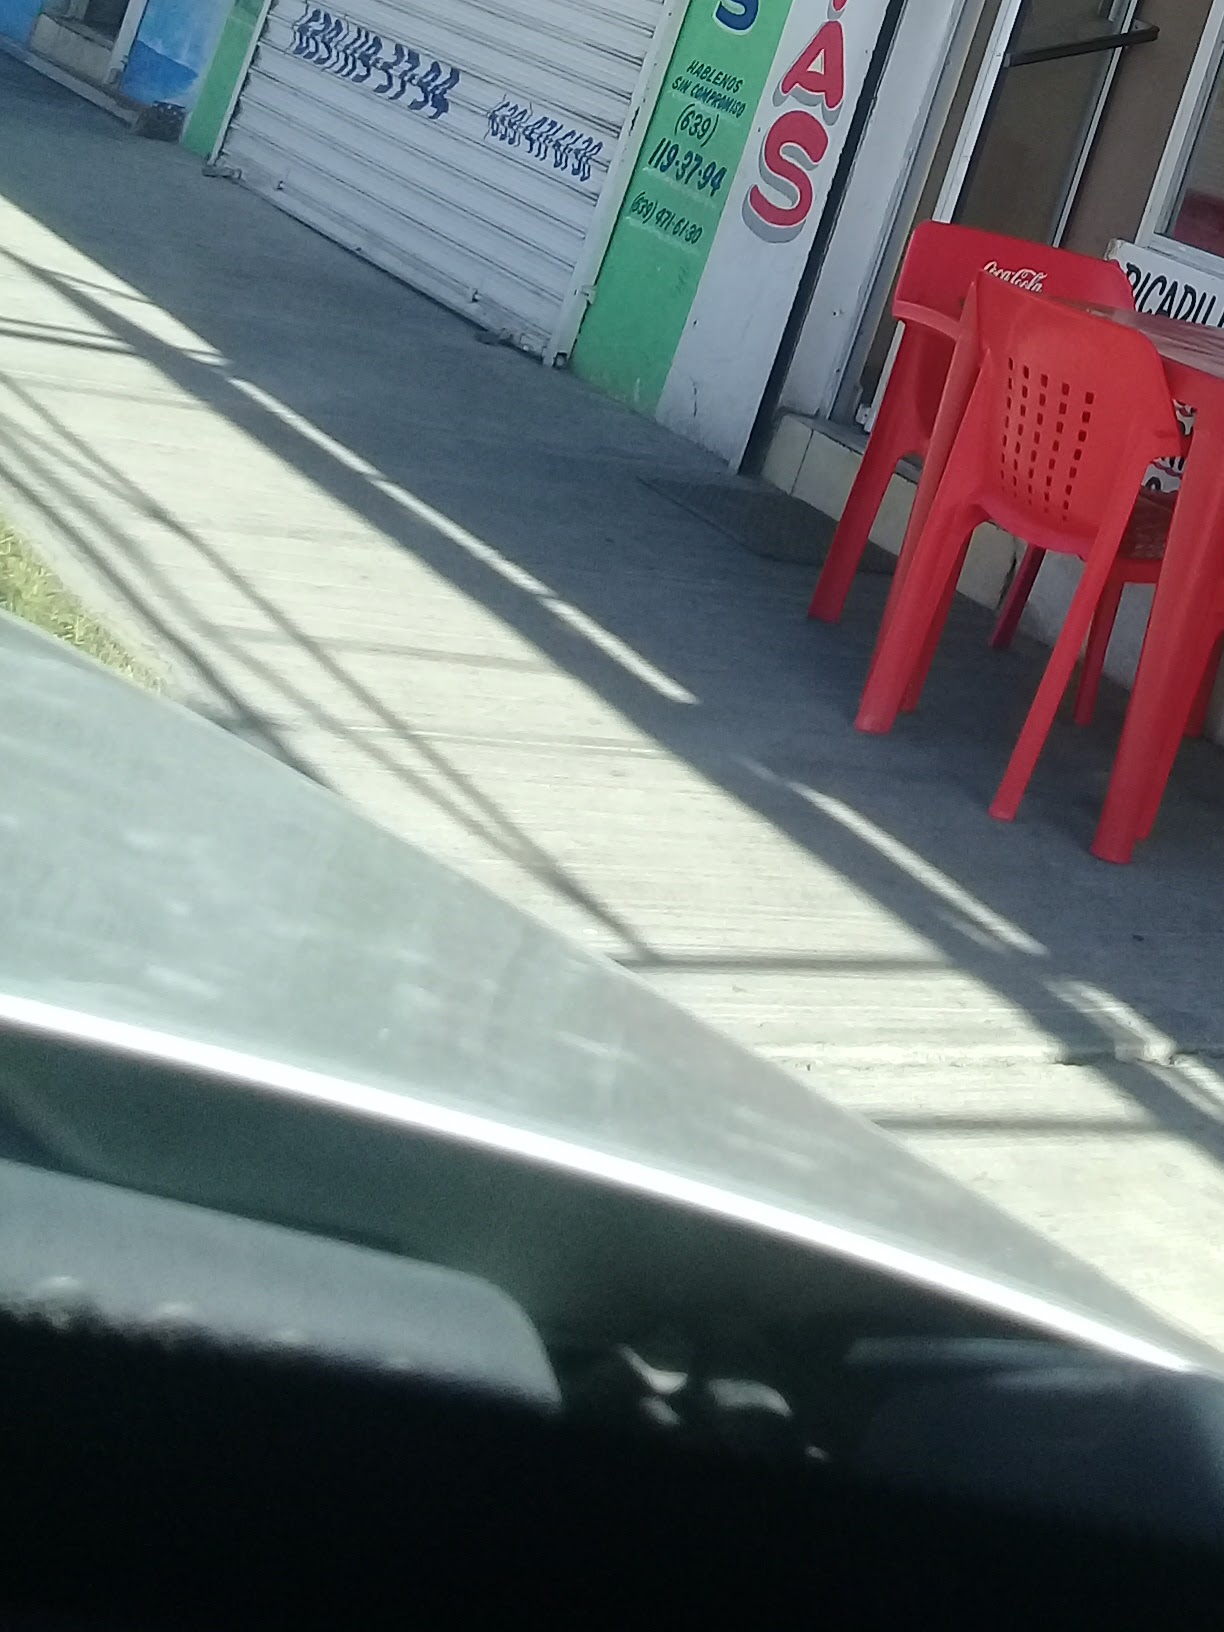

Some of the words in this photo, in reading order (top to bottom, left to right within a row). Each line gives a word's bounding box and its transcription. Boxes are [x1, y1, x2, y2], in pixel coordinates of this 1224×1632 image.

[671, 75, 693, 95] SIN
[689, 83, 747, 119] COMPROMISO
[686, 58, 744, 94] HABLENOS
[674, 102, 720, 149] (639)
